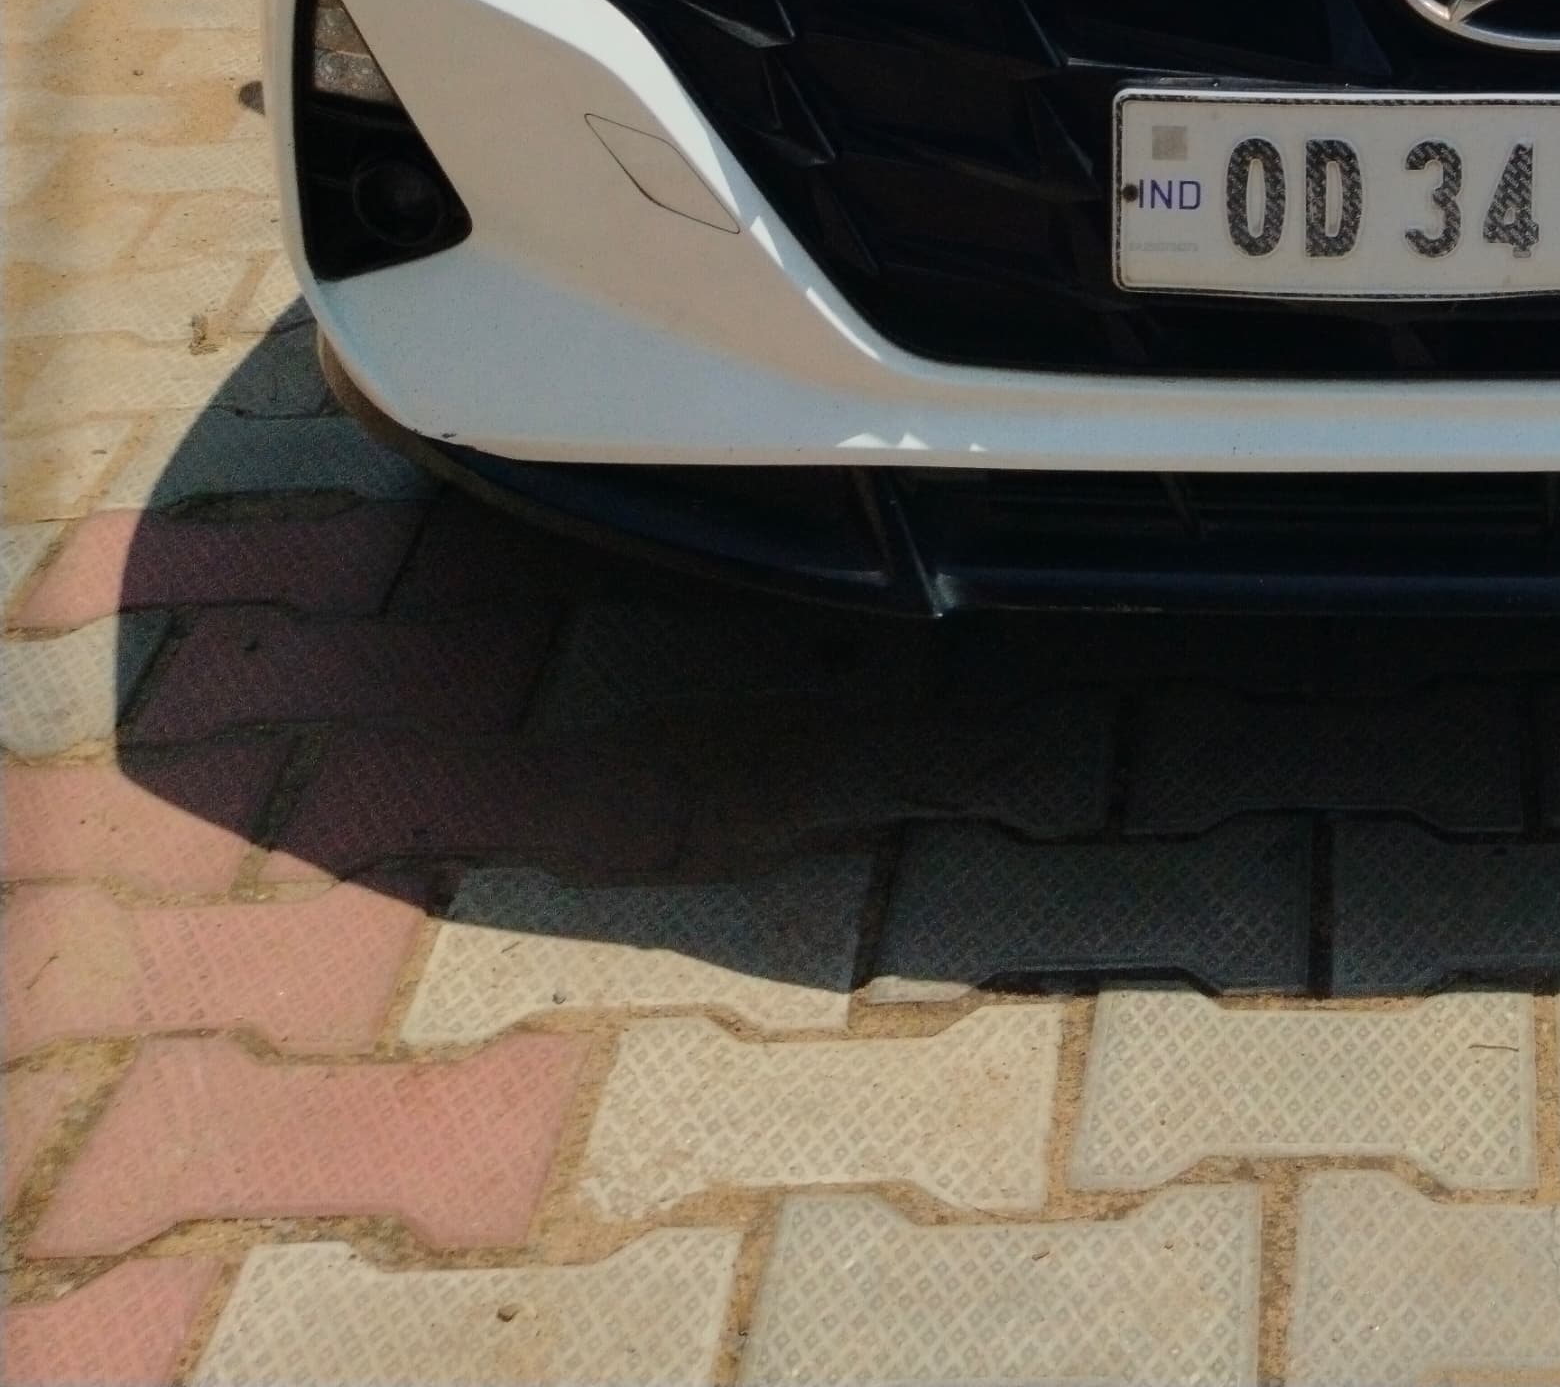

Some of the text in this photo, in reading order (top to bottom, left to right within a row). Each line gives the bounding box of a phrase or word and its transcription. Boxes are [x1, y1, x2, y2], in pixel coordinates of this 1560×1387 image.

[1138, 178, 1201, 210] IND
[1223, 135, 1364, 258] OD
[1404, 134, 1541, 259] 34
